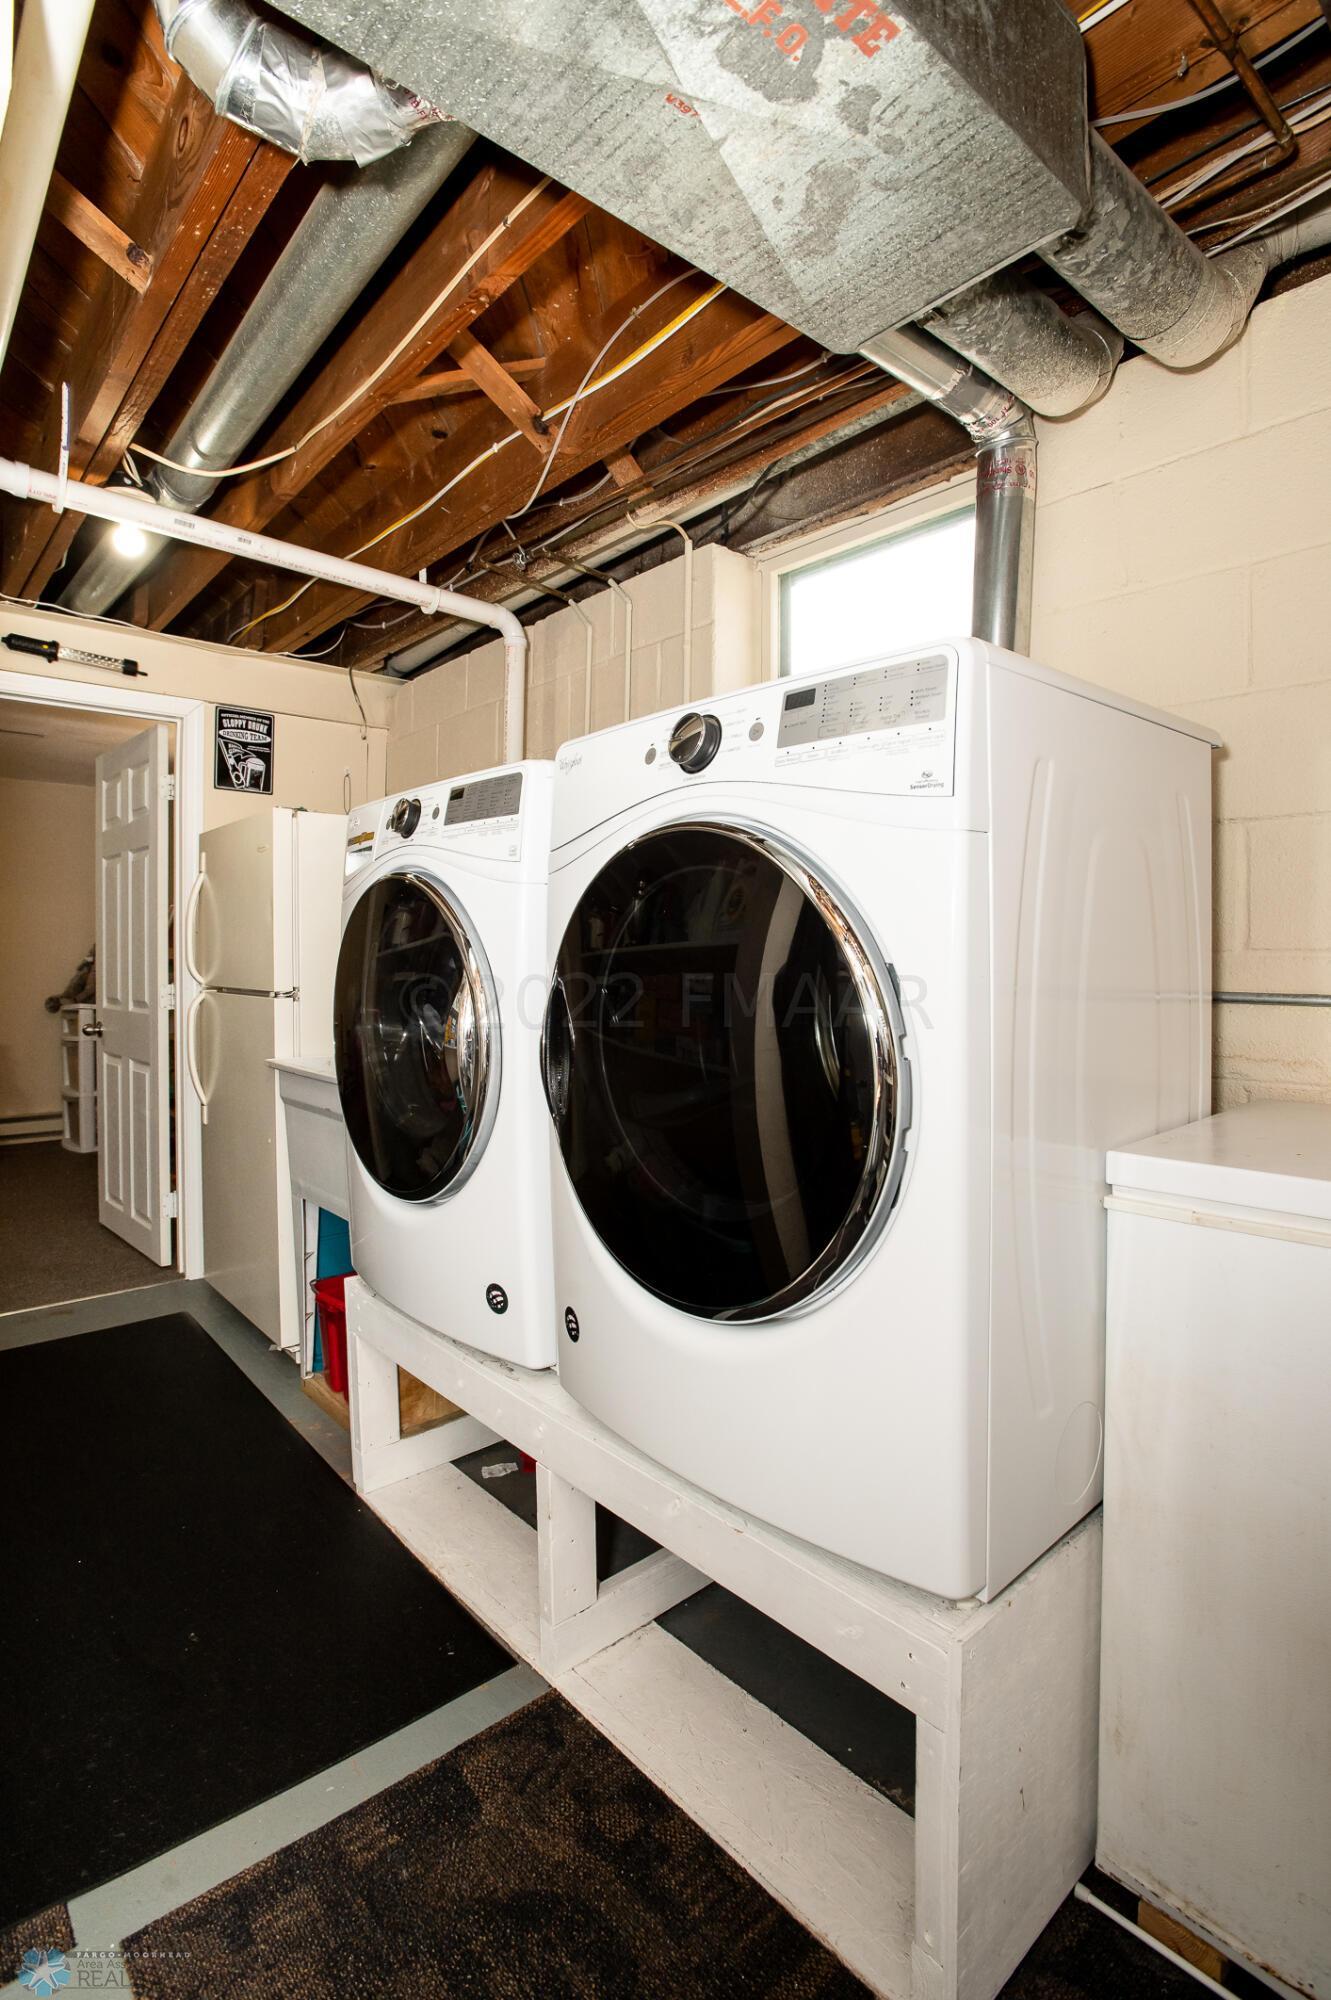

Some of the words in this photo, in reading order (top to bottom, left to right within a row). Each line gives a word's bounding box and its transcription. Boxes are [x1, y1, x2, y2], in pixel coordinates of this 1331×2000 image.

[815, 0, 902, 58] TE
[222, 718, 246, 728] SLOPPY
[248, 720, 268, 734] DRUNK
[222, 731, 248, 740] DRINKING
[249, 733, 268, 741] TEAM
